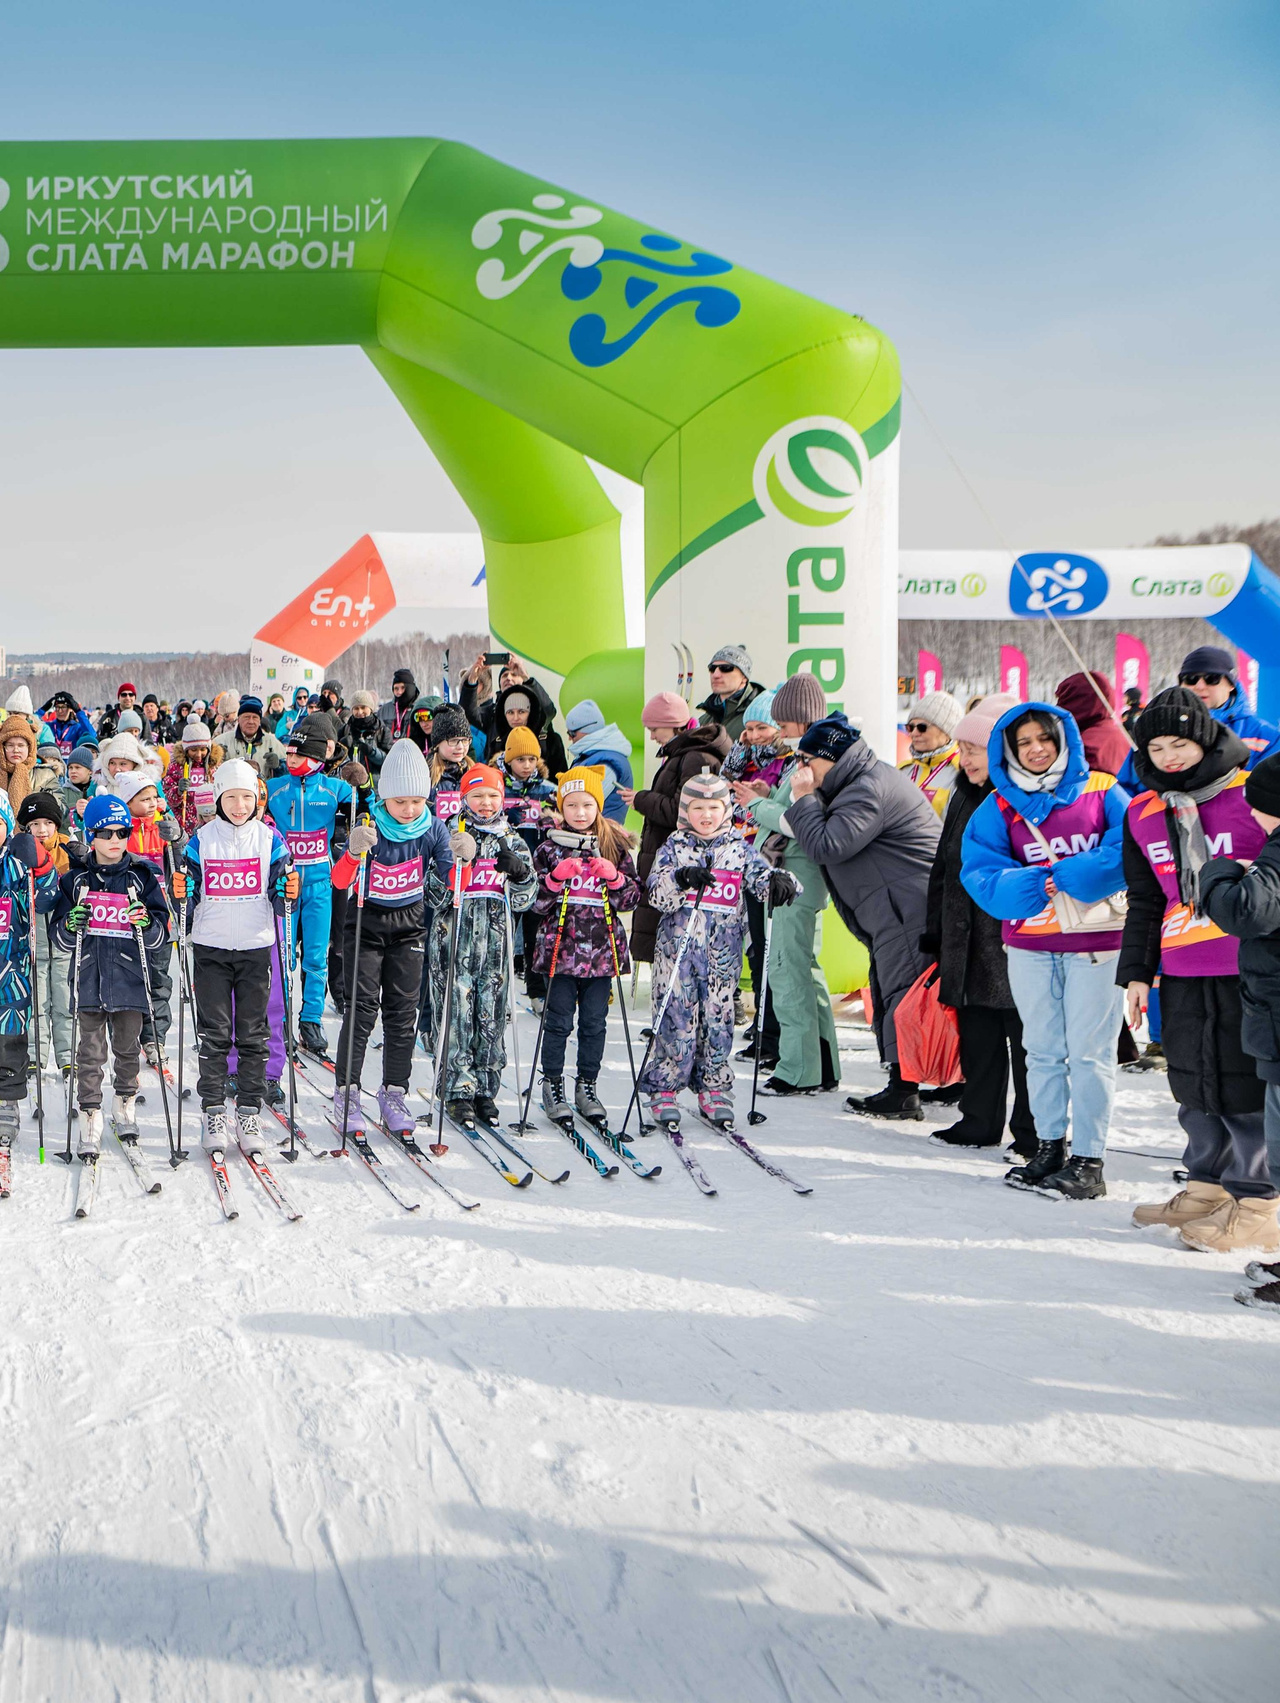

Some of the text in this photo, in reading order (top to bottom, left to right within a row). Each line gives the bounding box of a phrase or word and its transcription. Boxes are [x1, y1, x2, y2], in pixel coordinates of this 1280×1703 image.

[25, 168, 254, 200] ИРКУТСКИЙ
[25, 199, 388, 236] МЕЖДУНАРОДНЫЙ
[25, 240, 355, 271] СЛАТА МАРАФОН
[898, 574, 957, 596] лата
[1131, 575, 1203, 596] Слата
[310, 587, 375, 617] En+
[786, 546, 846, 714] ата
[289, 838, 325, 855] 1028
[1023, 833, 1099, 863] БАМ
[1147, 832, 1233, 864] БМ
[208, 871, 258, 889] 2036
[373, 868, 420, 890] 2054
[689, 882, 736, 900] 30
